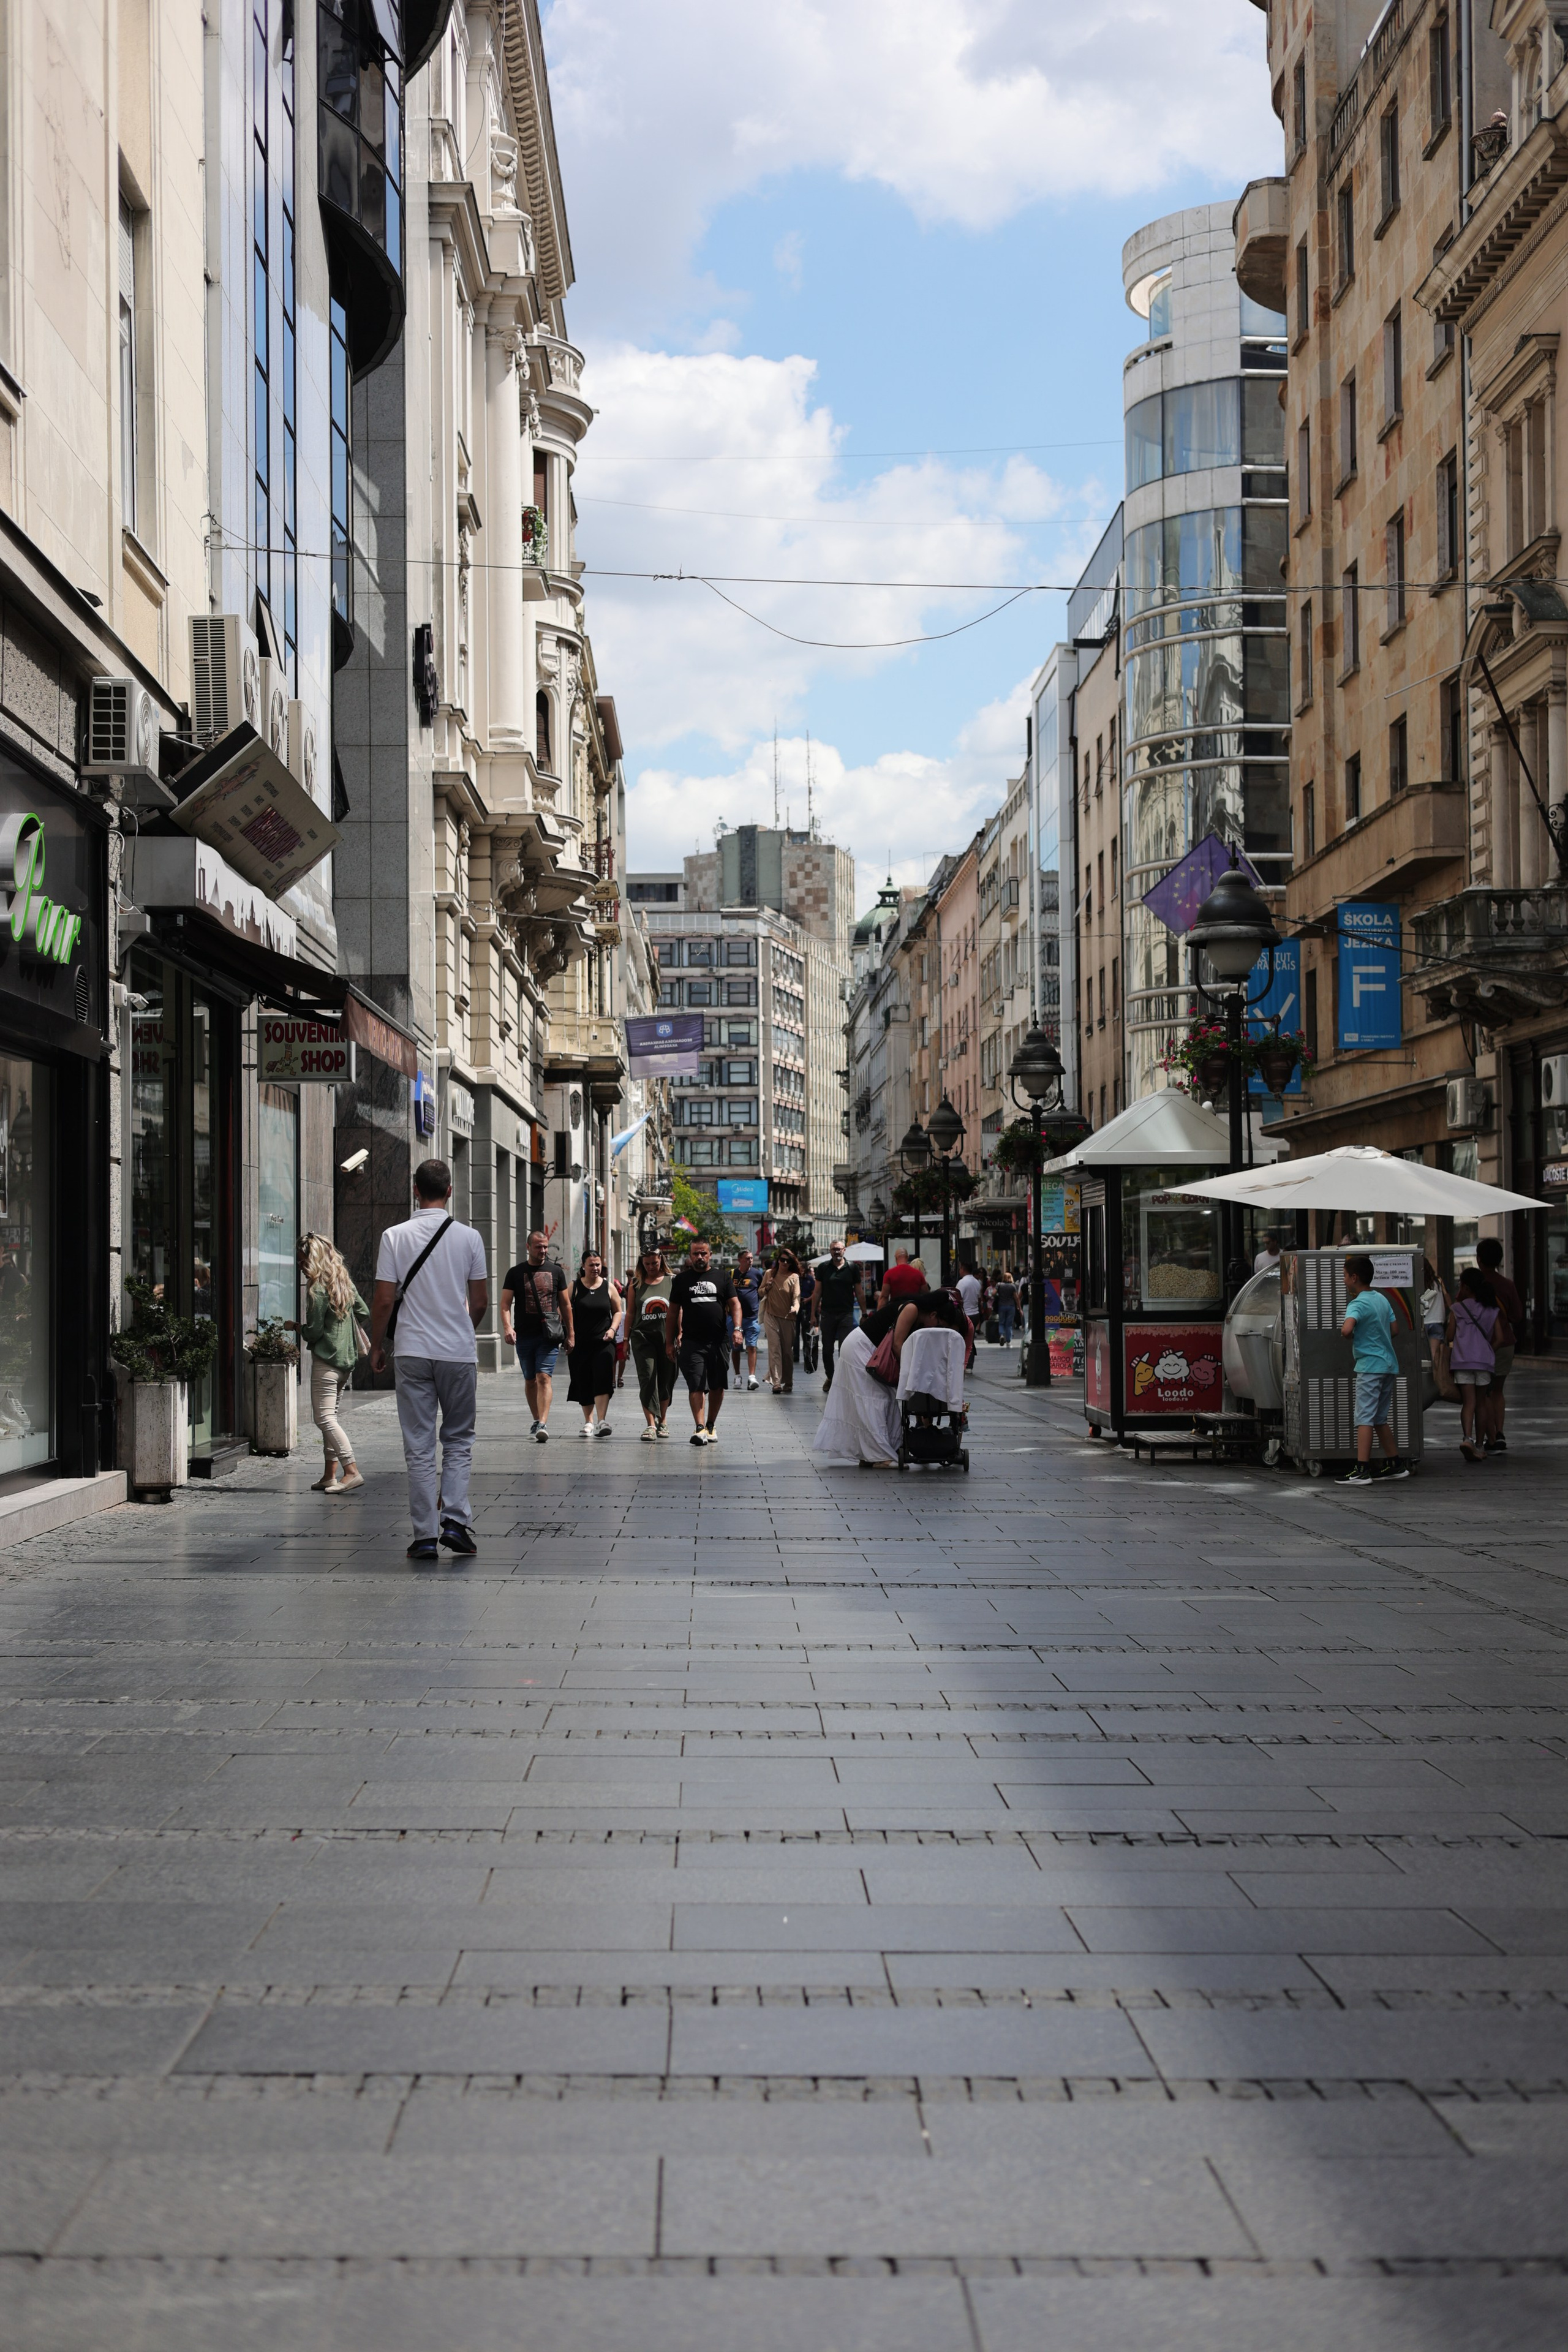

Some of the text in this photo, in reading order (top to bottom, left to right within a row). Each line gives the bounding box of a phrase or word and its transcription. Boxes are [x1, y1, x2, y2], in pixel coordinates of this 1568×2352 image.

[1344, 911, 1393, 925] ŠKOLA
[1352, 966, 1385, 1008] F
[300, 1049, 345, 1072] SHOP
[1543, 1167, 1564, 1182] LACOSTE
[1152, 1193, 1170, 1204] POP
[1158, 1388, 1194, 1397] Loodo
